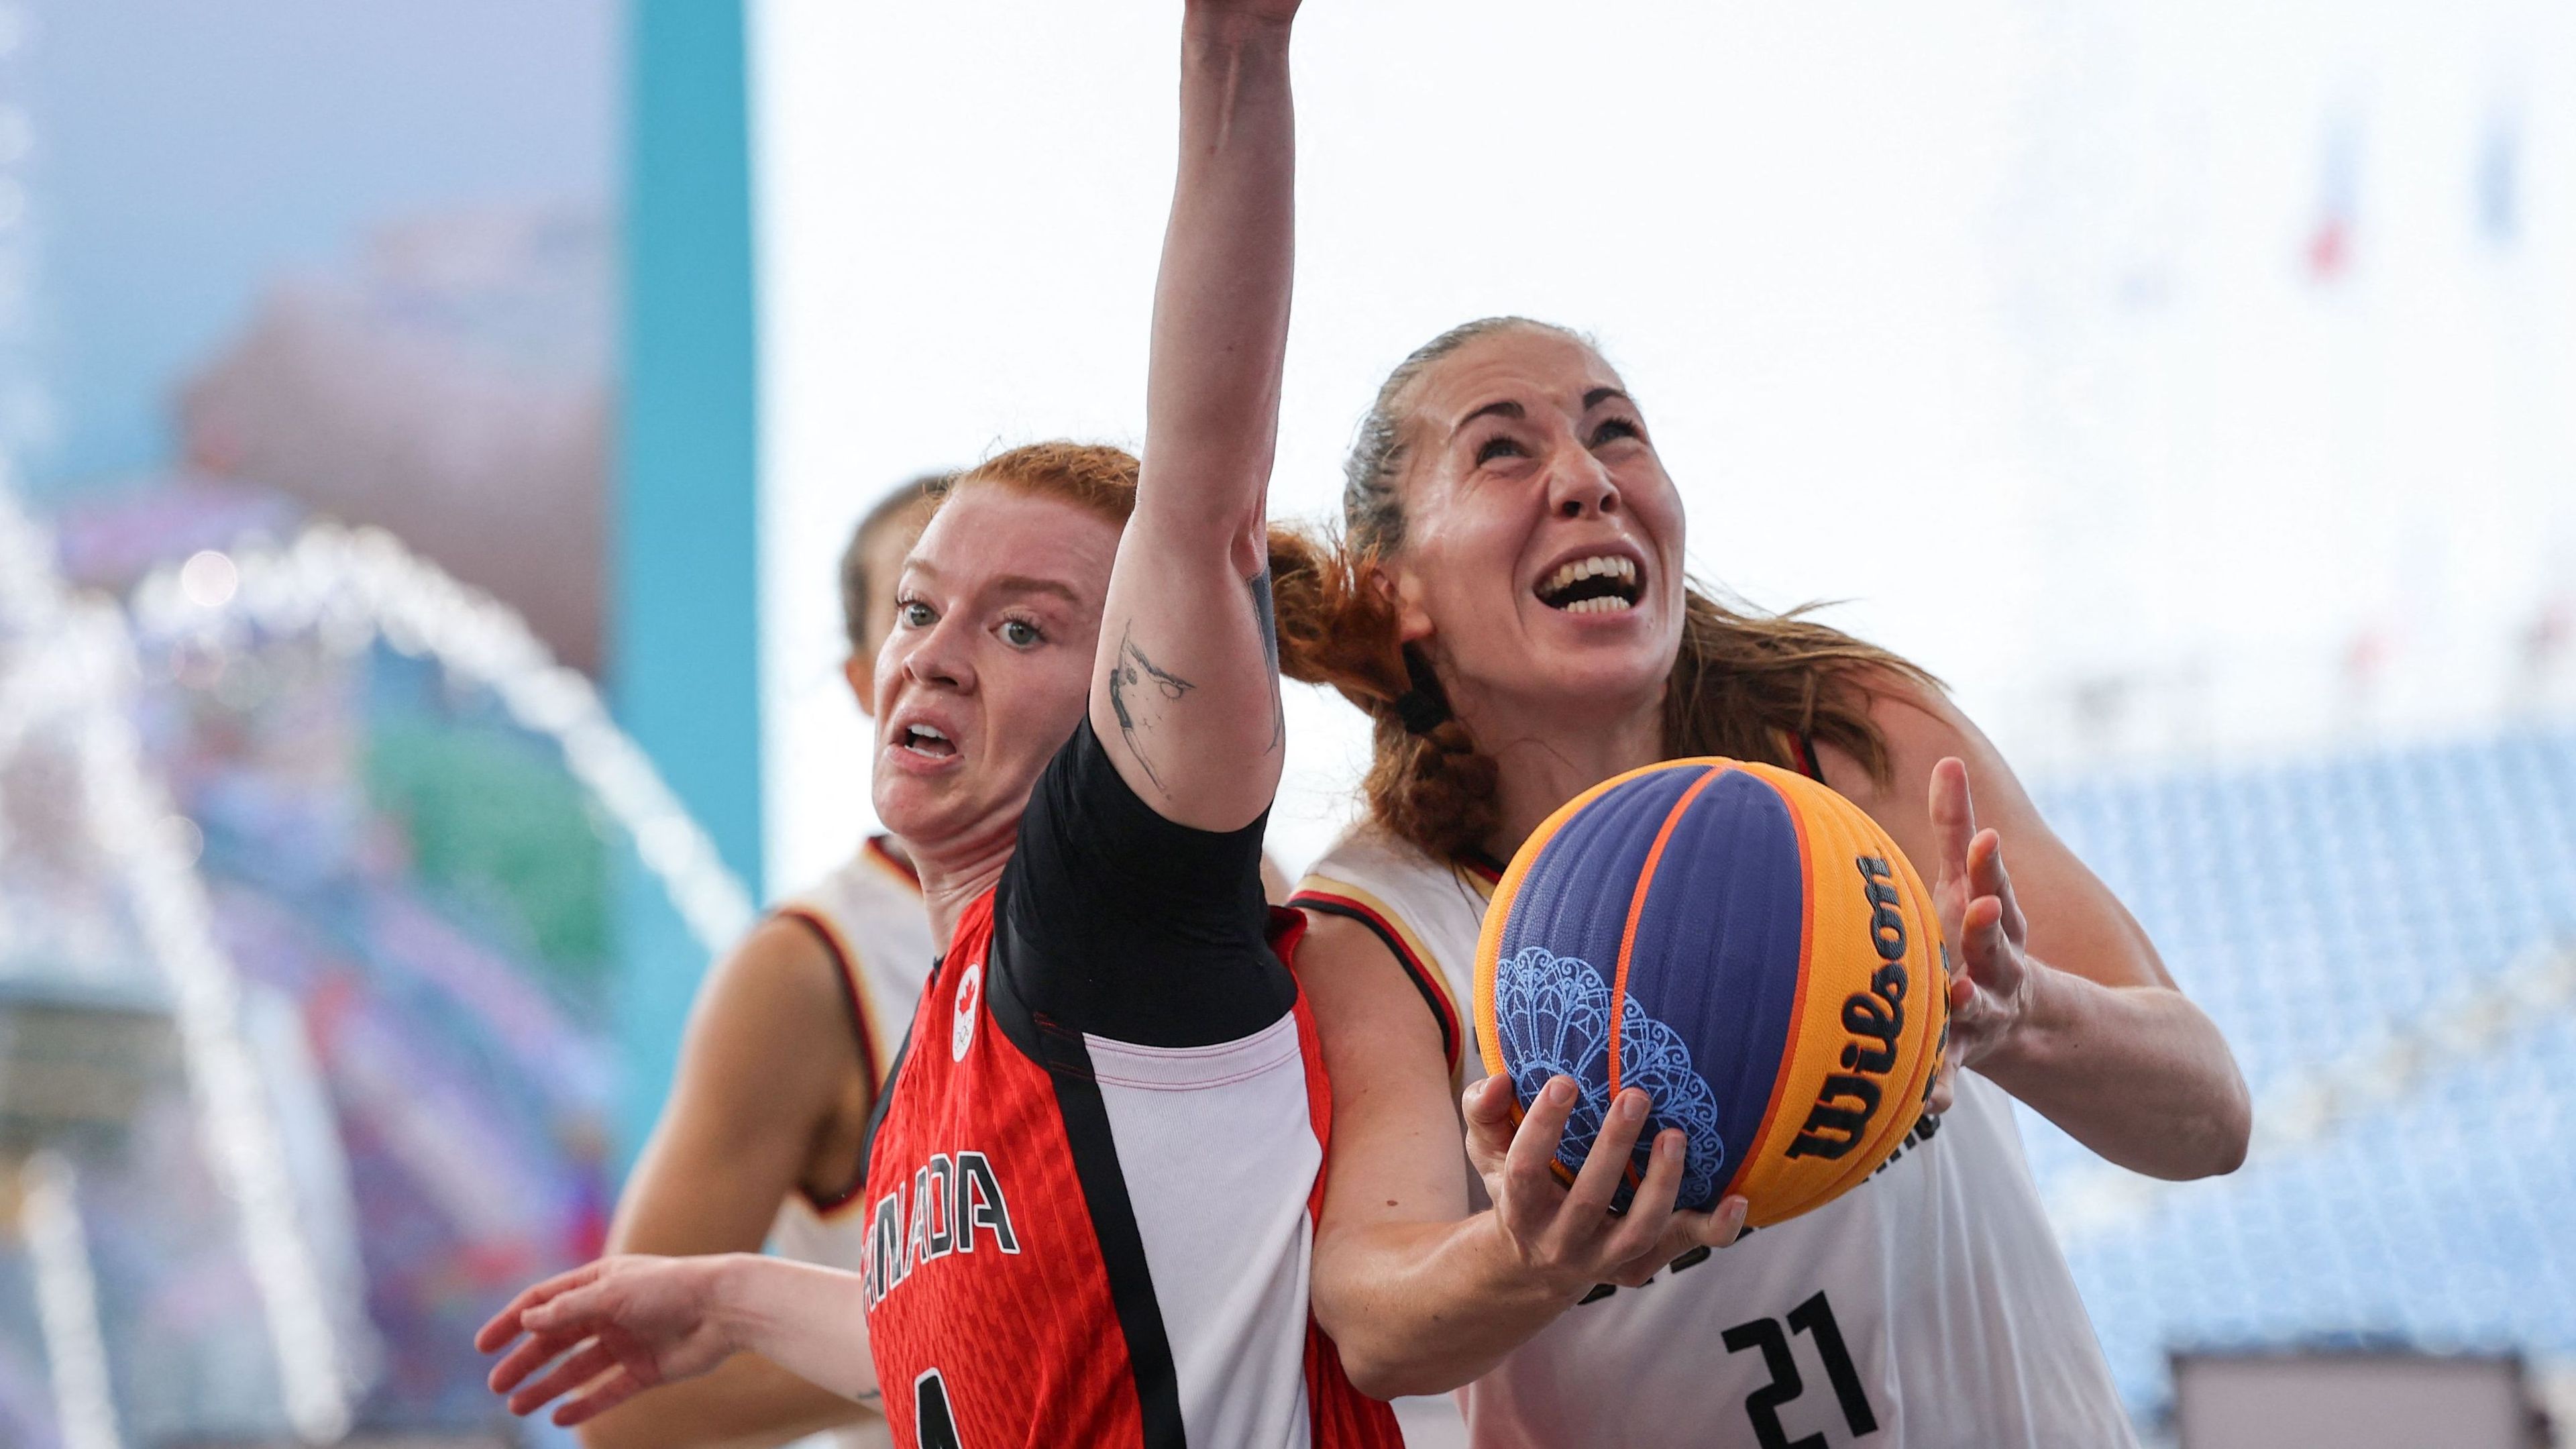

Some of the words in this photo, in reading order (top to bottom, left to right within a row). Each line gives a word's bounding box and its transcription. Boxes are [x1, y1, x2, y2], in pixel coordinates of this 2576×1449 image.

[1785, 855, 1909, 1160] Wilson
[862, 1150, 1020, 1313] ANADA
[1721, 1289, 1878, 1449] 21
